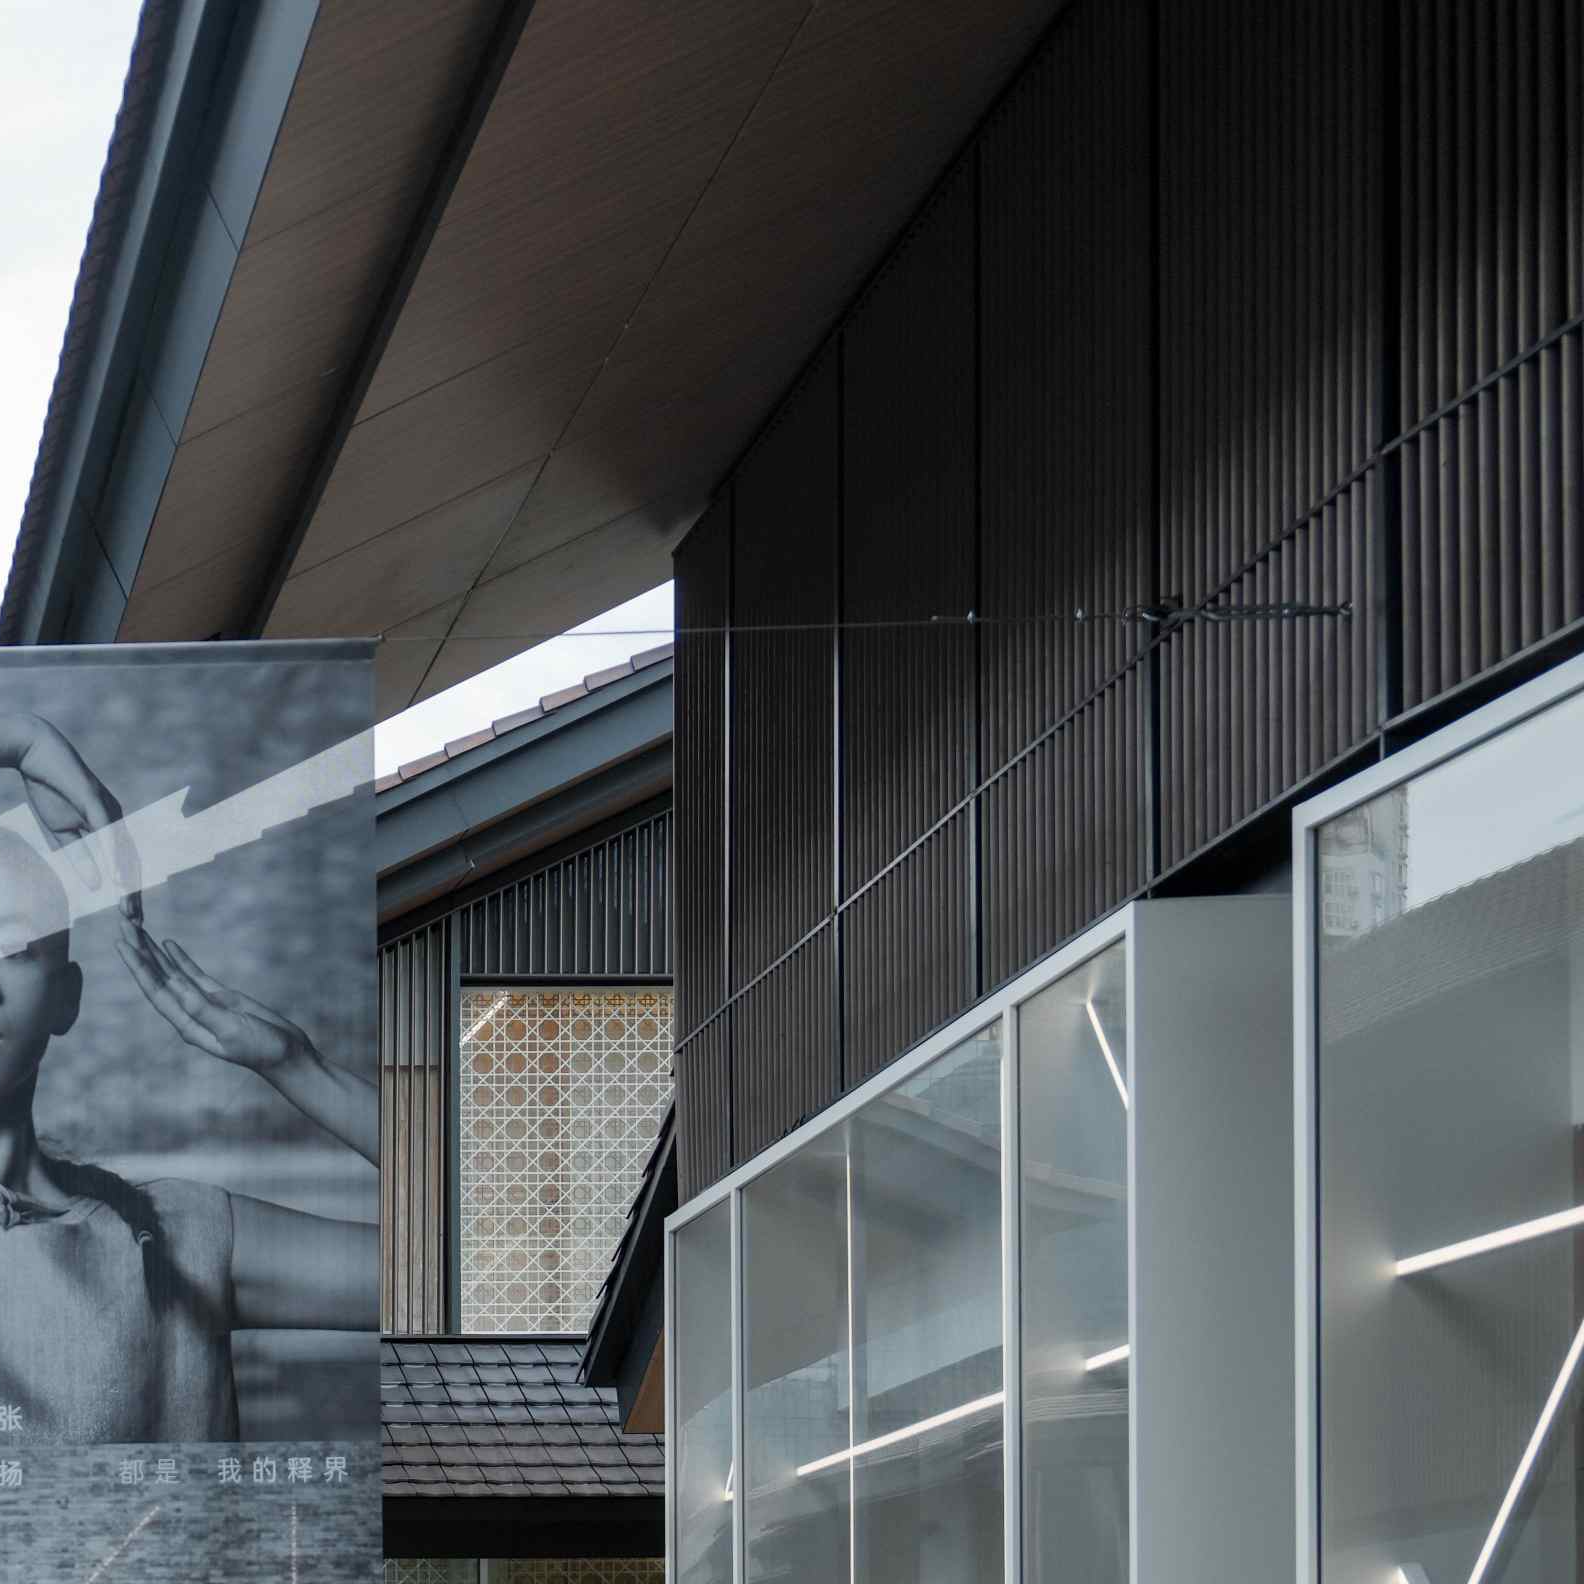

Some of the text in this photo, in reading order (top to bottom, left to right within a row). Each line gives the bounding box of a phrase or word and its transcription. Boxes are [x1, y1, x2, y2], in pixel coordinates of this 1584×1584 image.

[119, 1458, 181, 1485] 都是
[217, 1456, 349, 1484] 我的释界
